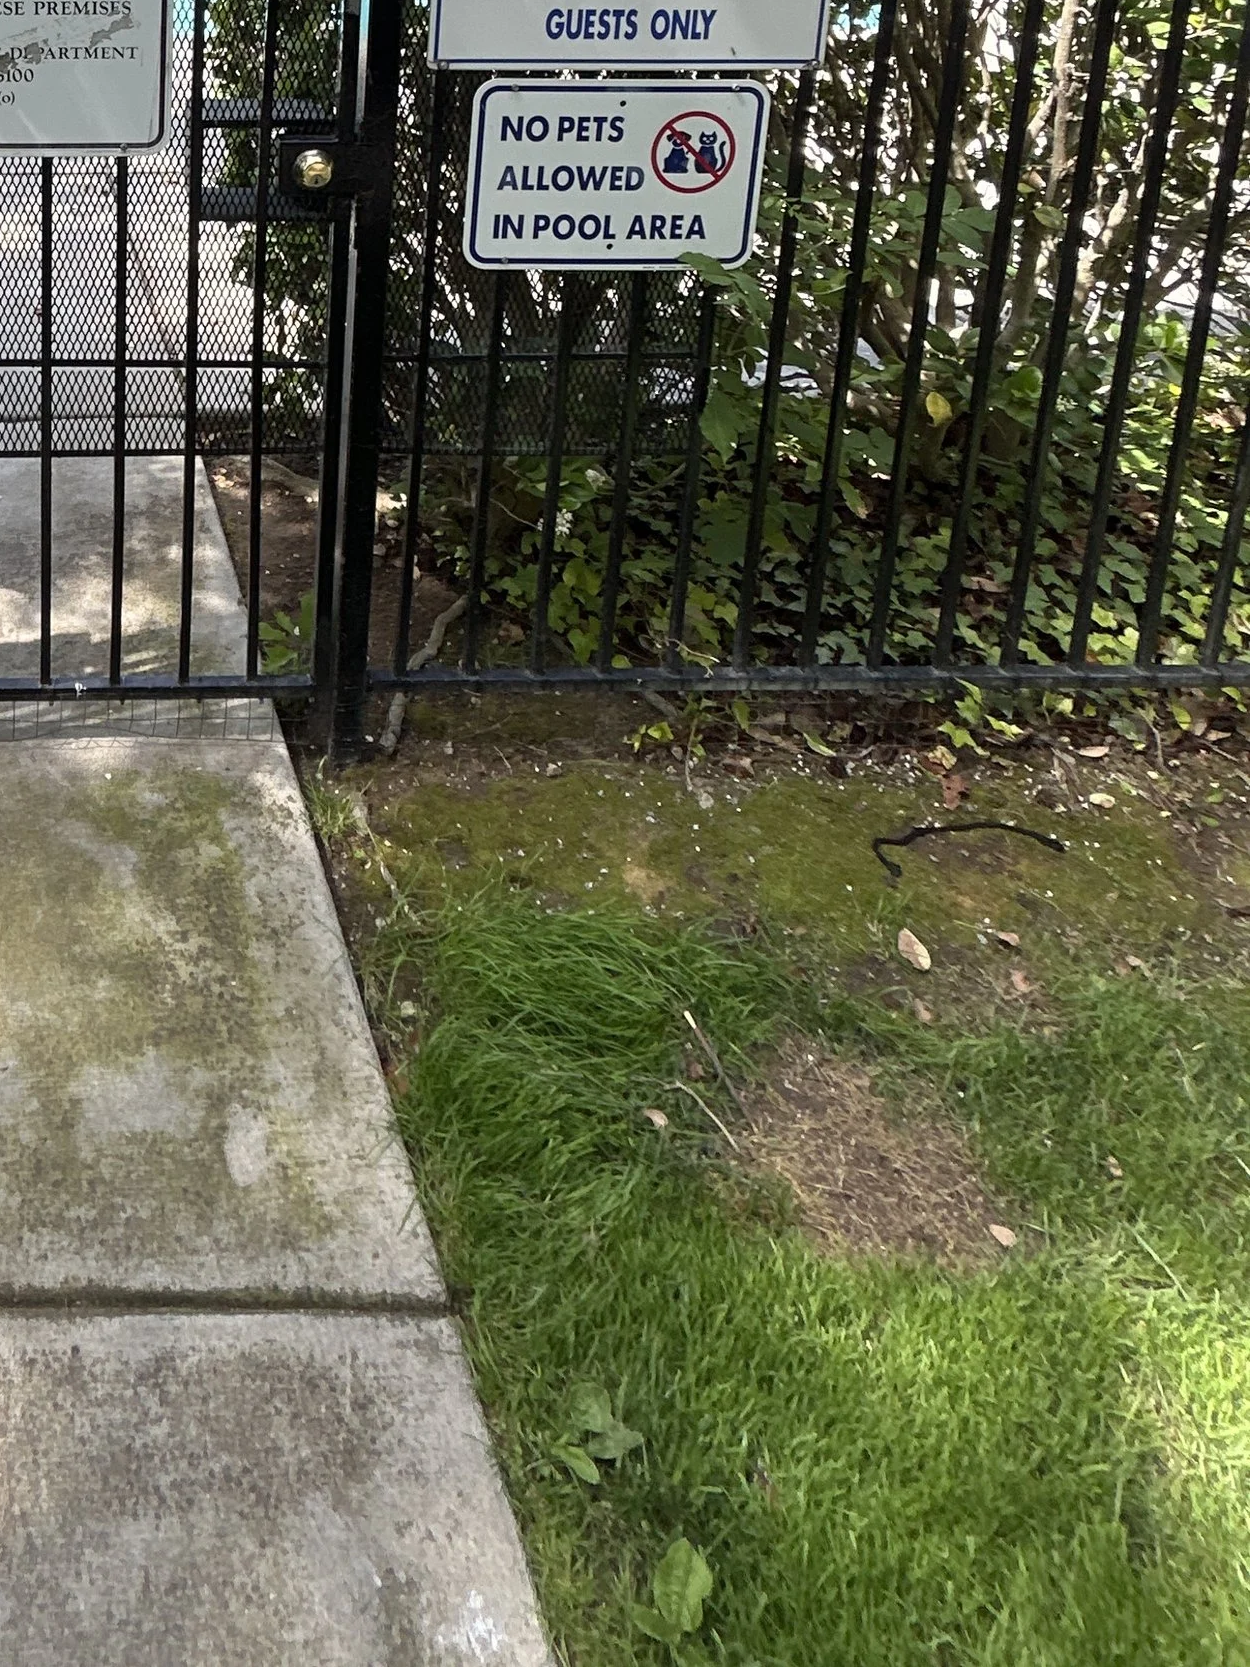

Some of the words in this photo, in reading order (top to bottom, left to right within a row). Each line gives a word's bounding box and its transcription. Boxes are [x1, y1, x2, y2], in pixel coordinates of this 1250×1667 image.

[34, 1, 132, 16] PREMISES
[546, 9, 638, 40] GUESTS
[650, 9, 717, 40] ONLY
[500, 116, 550, 142] NO
[557, 116, 625, 142] PETS
[497, 166, 645, 191] ALLOWED
[492, 214, 524, 240] IN
[532, 214, 616, 240] POOL
[625, 215, 706, 240] AREA
